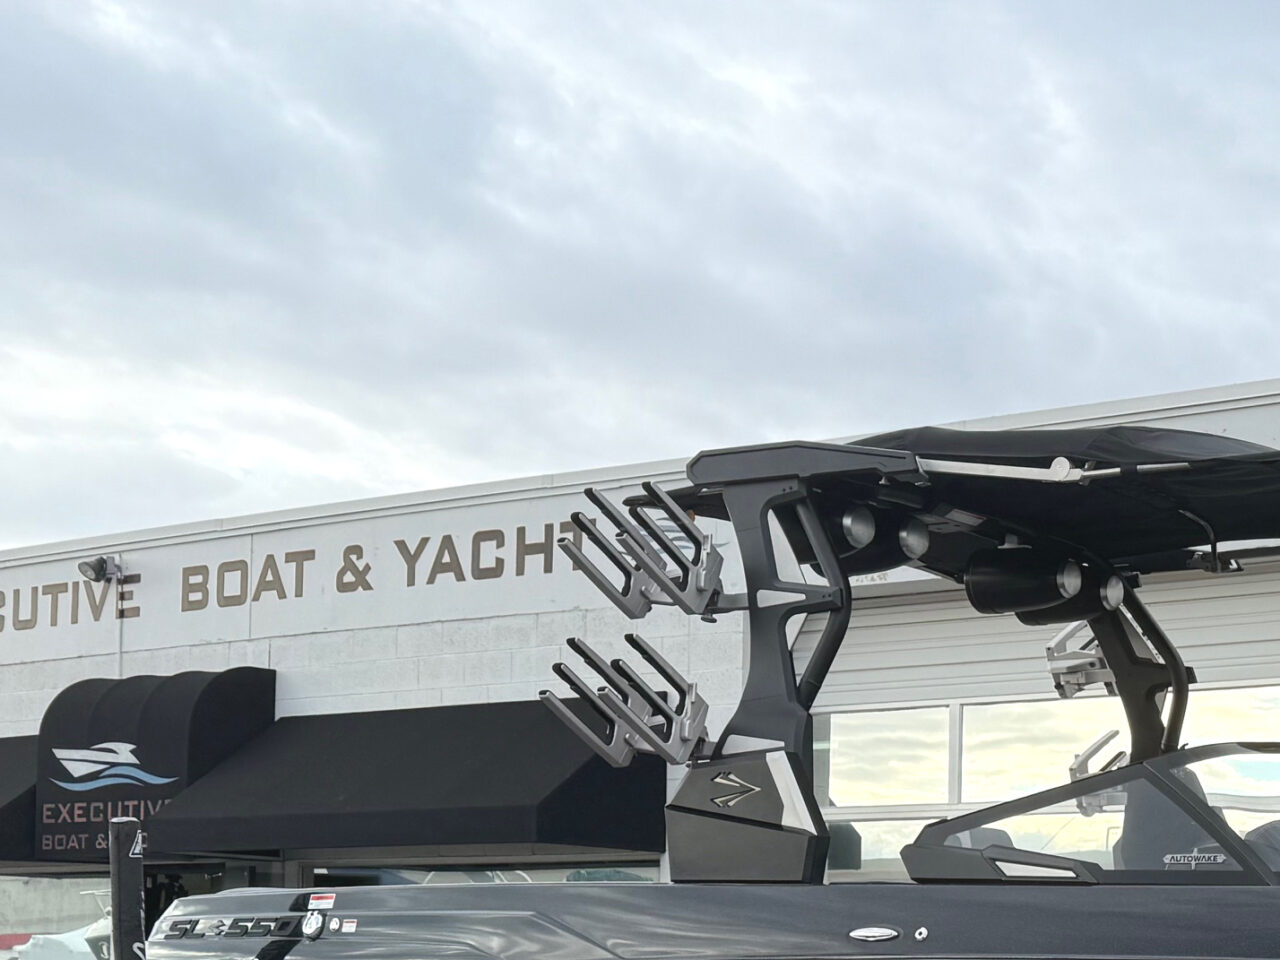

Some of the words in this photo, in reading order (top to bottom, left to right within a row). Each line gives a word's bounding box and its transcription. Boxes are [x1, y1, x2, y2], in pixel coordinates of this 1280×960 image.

[0, 573, 141, 632] UTIVE
[181, 549, 315, 612] BOAT
[336, 544, 374, 593] &
[393, 518, 597, 587] YACHT
[42, 799, 173, 824] EXECUTIV
[42, 833, 89, 850] BOAT
[95, 833, 107, 849] &
[1169, 855, 1219, 863] AUTOWAKE
[164, 918, 206, 940] SL
[223, 917, 303, 938] 550
